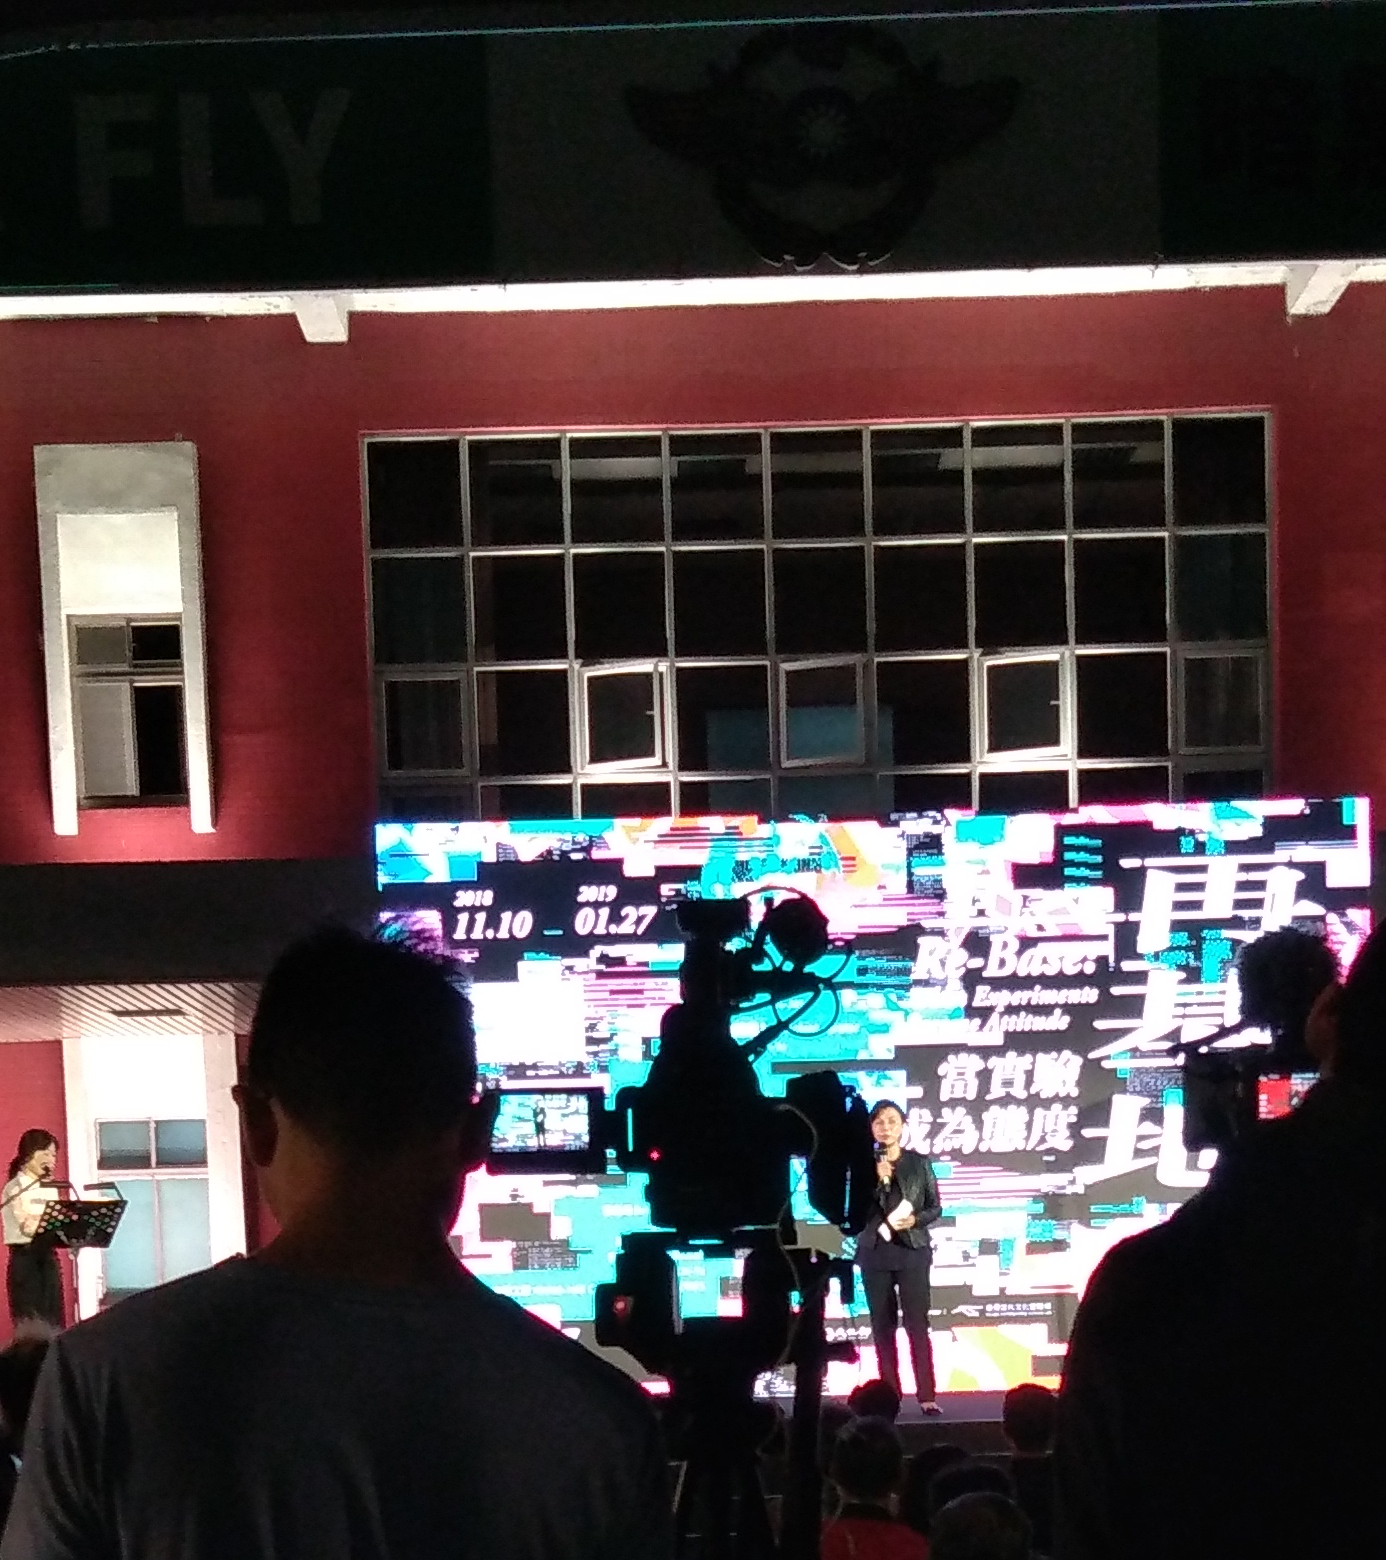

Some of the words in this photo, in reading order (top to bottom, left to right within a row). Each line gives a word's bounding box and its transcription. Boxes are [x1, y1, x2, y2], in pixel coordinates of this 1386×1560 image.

[71, 86, 353, 232] FLY
[576, 884, 618, 903] 2019
[452, 910, 534, 940] 11.10
[574, 906, 659, 935] 01.27
[972, 985, 1100, 1012] Experiments
[982, 1008, 1072, 1033] Attitude
[937, 1050, 1084, 1101] 當實驗
